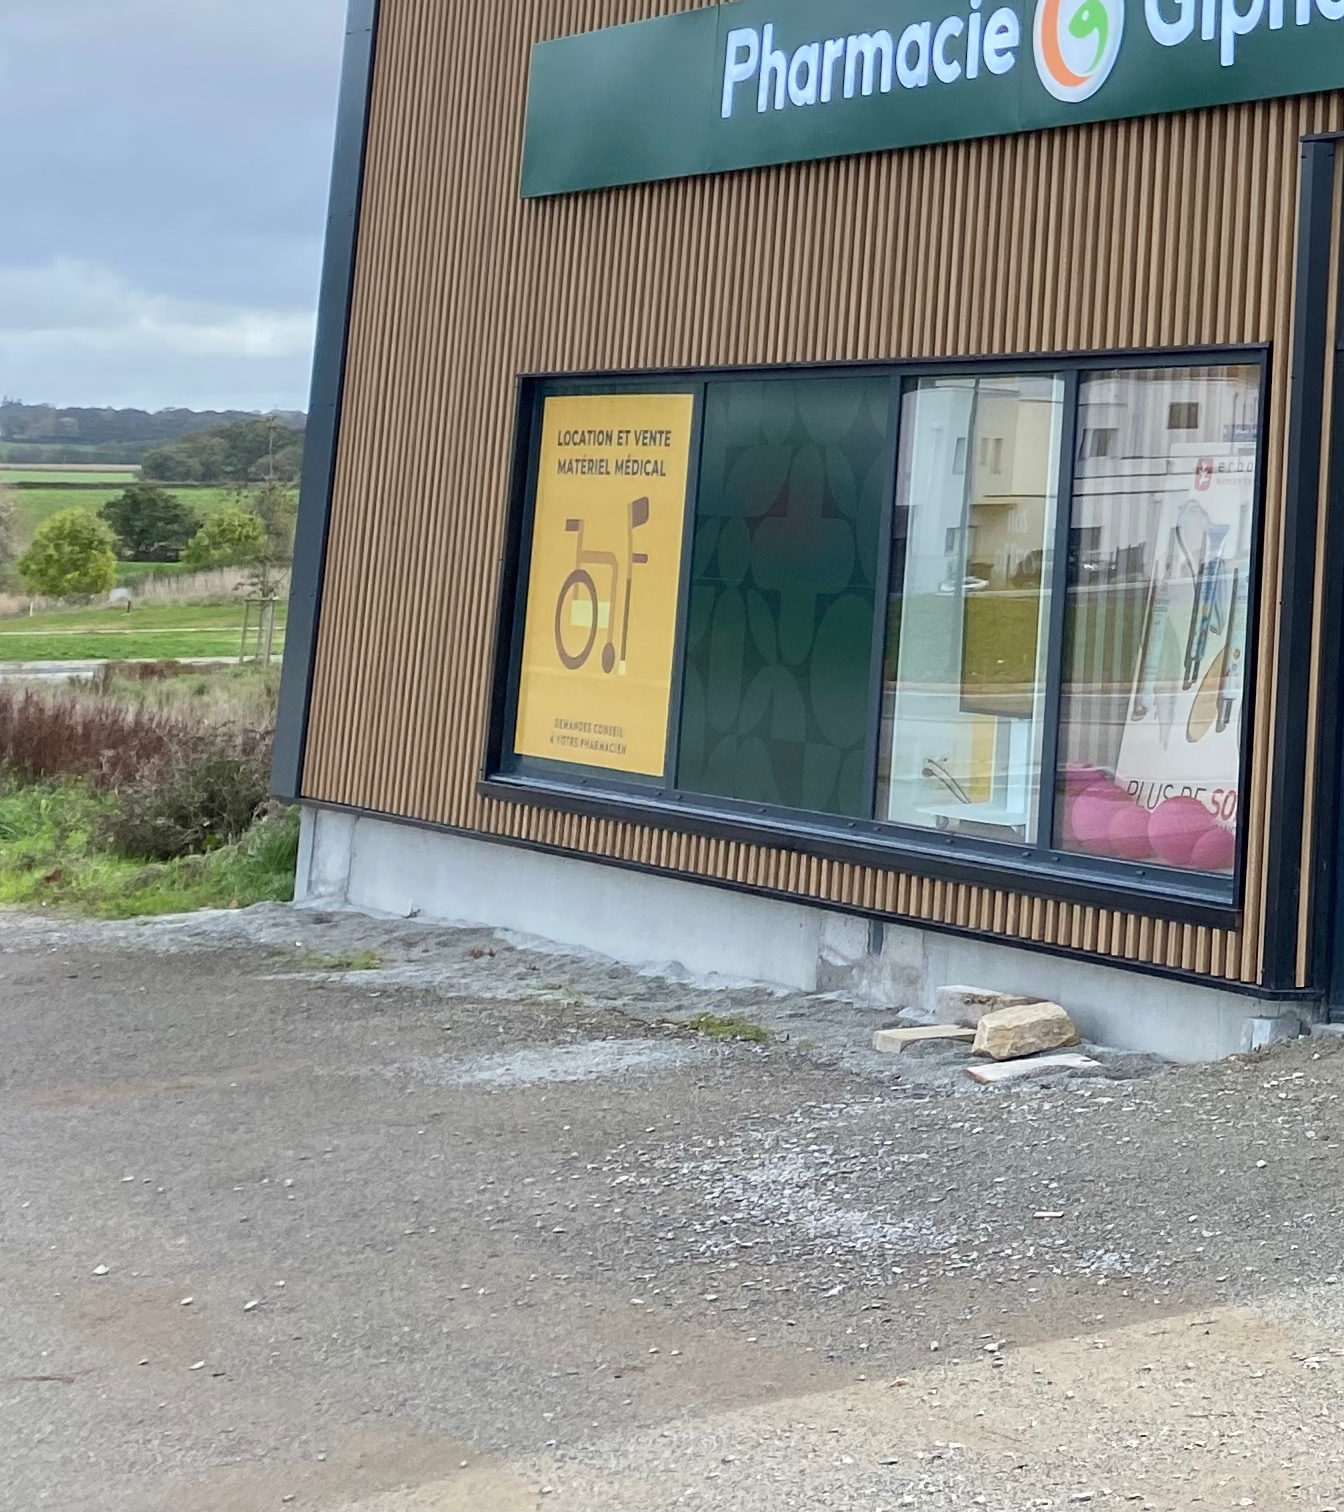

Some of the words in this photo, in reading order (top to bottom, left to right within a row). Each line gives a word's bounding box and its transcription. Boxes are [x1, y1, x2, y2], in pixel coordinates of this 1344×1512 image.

[557, 429, 614, 446] LOCATION
[617, 430, 631, 446] ET
[634, 430, 672, 447] VENTE
[557, 454, 611, 475] MATÉRIEL
[615, 454, 666, 477] MÉDICAL
[554, 718, 592, 734] DEMANDEZ
[593, 723, 623, 739] CONSEIL
[556, 735, 579, 748] VOTRE
[580, 738, 627, 755] PHARMACIEN
